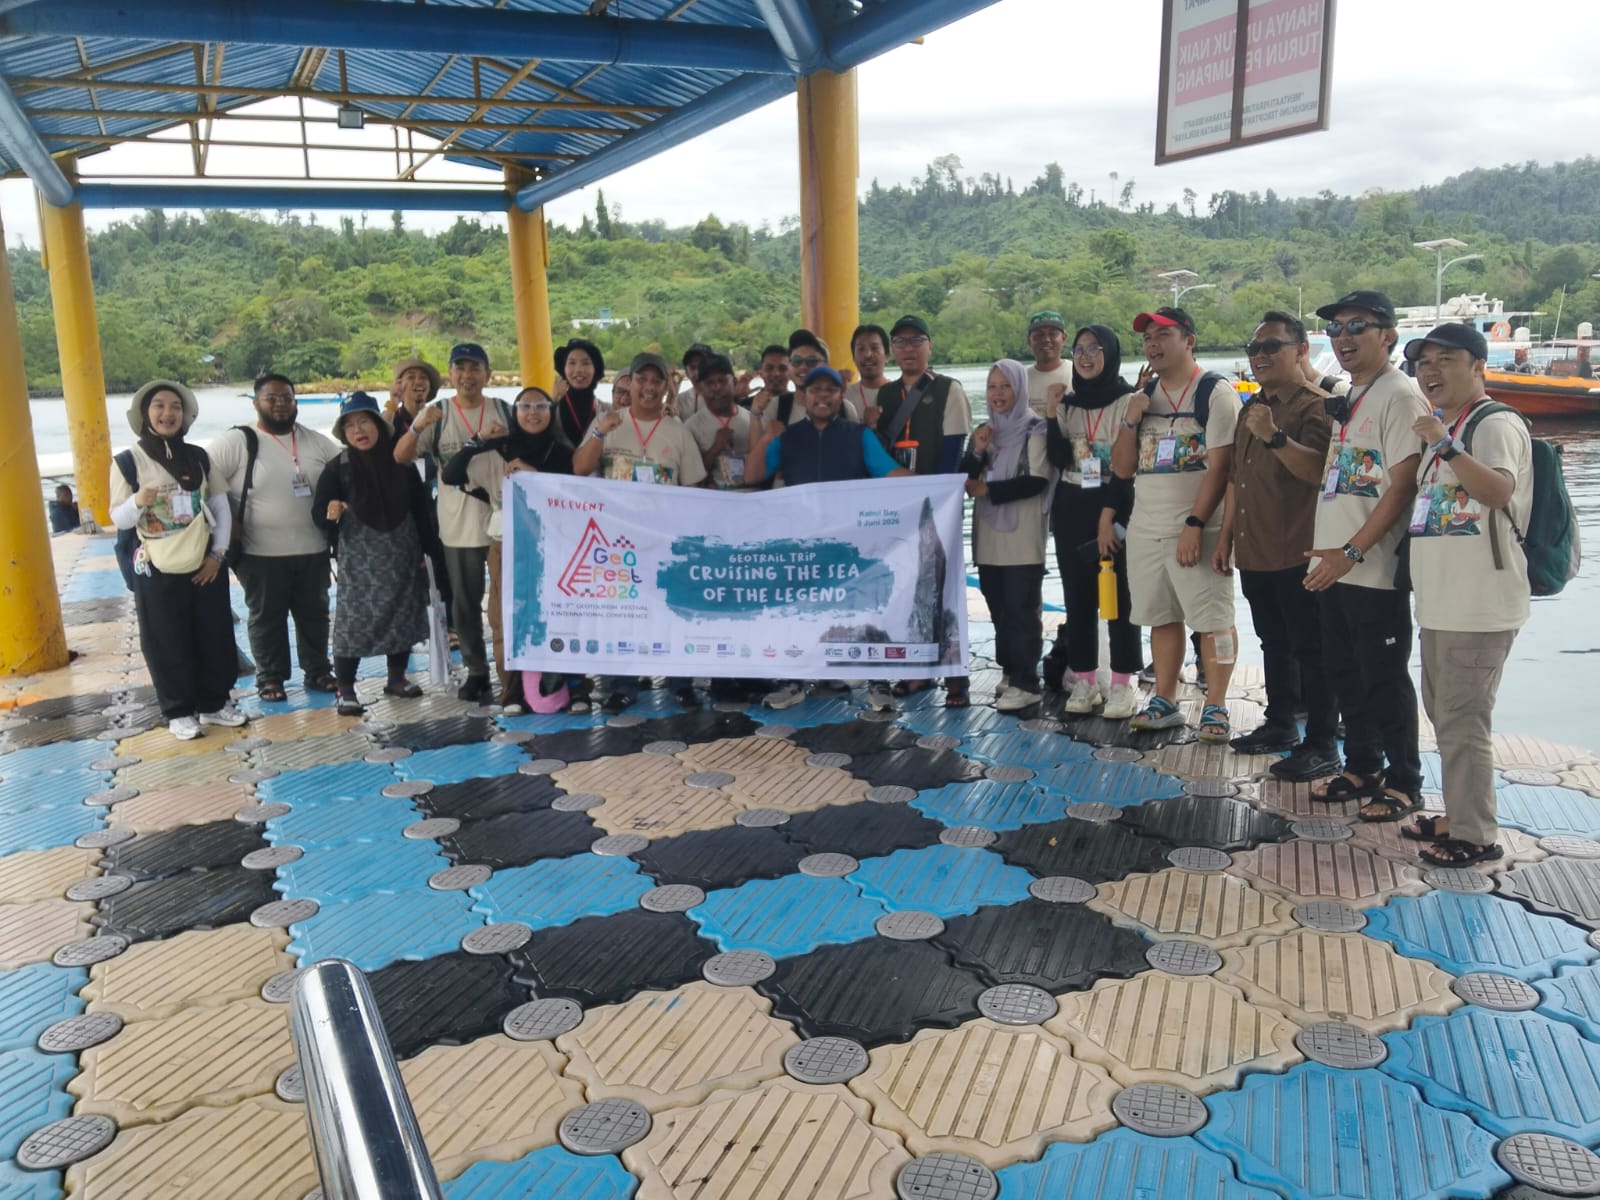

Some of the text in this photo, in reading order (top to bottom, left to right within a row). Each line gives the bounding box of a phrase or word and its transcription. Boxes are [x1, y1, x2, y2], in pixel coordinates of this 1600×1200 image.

[783, 564, 821, 581] THE
[828, 563, 860, 579] SEA
[596, 584, 638, 599] 2026
[703, 587, 846, 603] OF THE LEGEND
